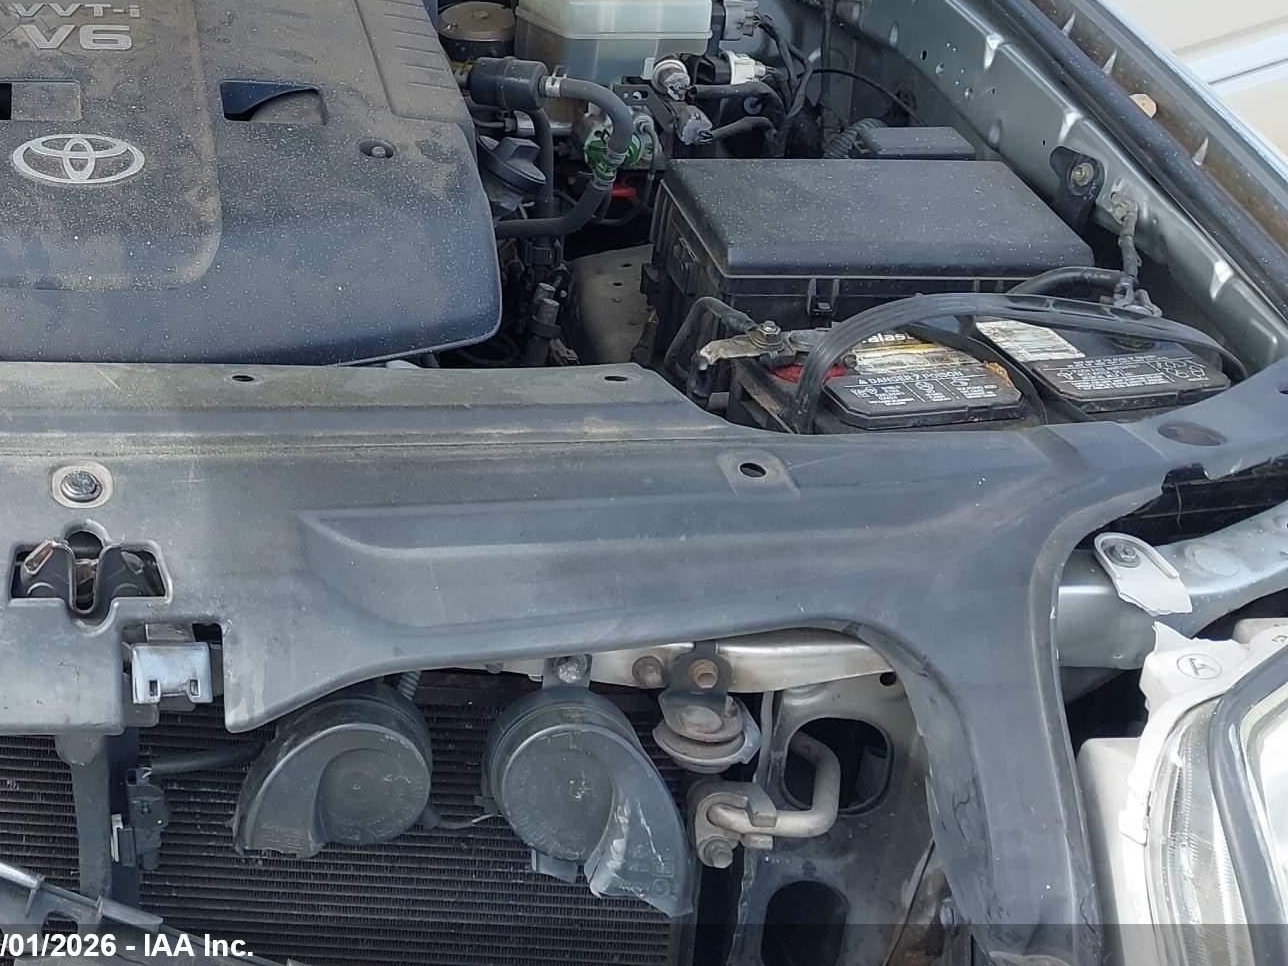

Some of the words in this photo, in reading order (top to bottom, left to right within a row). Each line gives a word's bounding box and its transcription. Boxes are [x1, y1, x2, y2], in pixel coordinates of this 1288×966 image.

[11, 2, 141, 19] VVT-i
[20, 24, 133, 50] V6
[867, 374, 913, 385] DANGER
